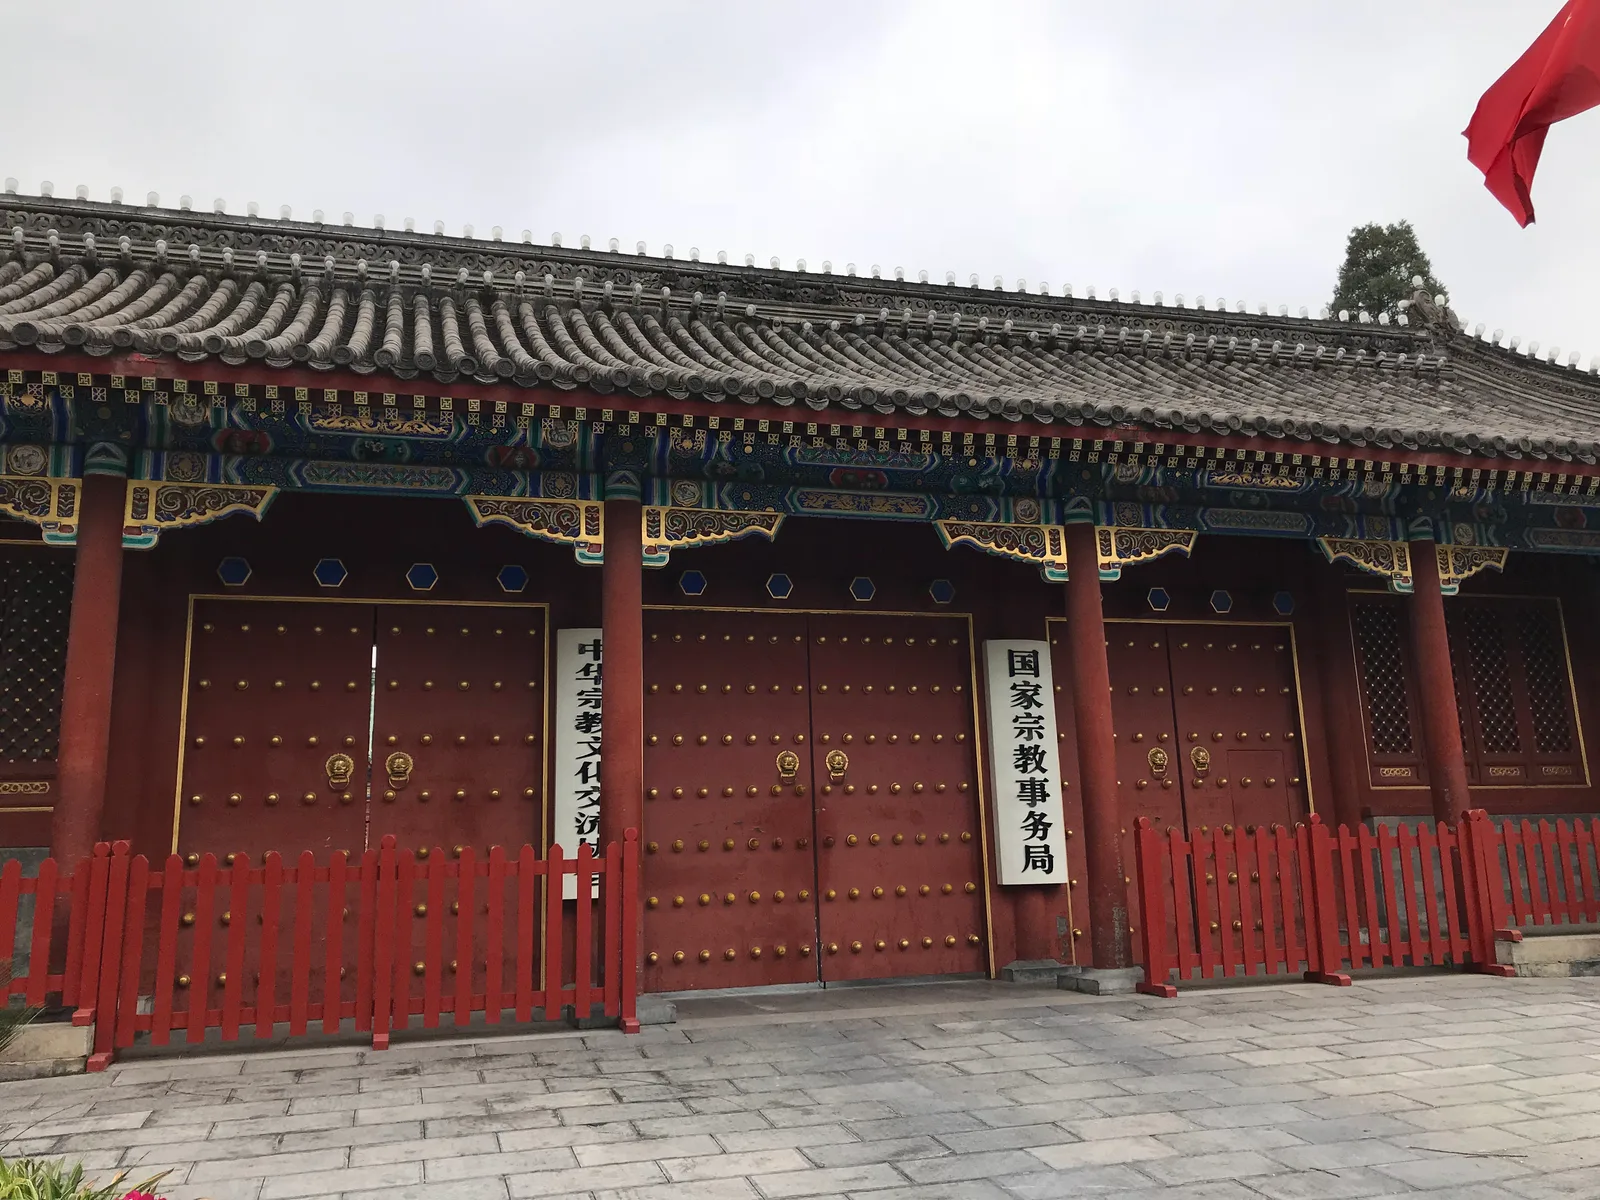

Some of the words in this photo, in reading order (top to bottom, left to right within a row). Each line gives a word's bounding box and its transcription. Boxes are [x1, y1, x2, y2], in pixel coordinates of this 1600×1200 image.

[574, 639, 602, 886] 中华宗教文化交流
[1007, 649, 1055, 875] 国家宗教事务局
